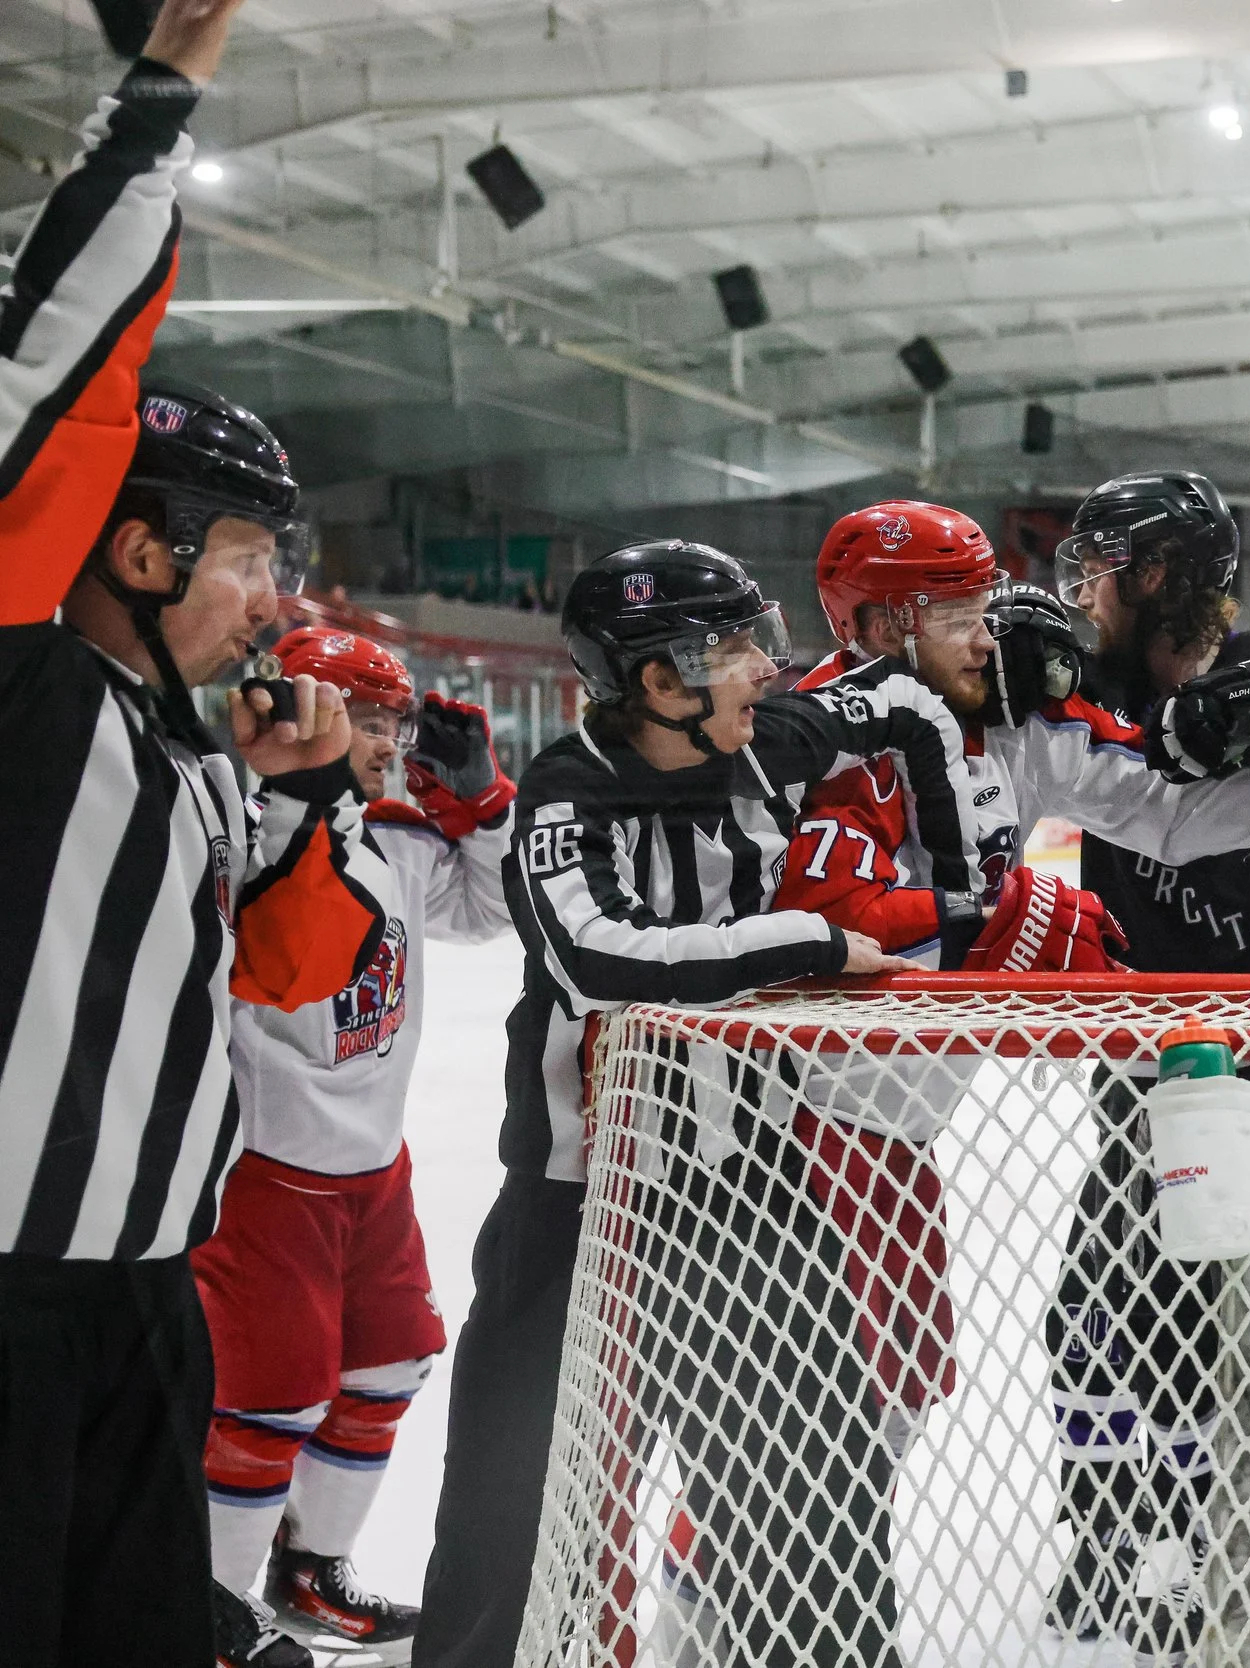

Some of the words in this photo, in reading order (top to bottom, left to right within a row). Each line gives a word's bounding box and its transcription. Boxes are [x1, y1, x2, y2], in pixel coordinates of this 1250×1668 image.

[625, 574, 652, 586] FPHL
[1045, 618, 1071, 632] ALPHA
[529, 823, 584, 874] 86
[800, 819, 876, 881] 77
[337, 1023, 378, 1061] ROCK
